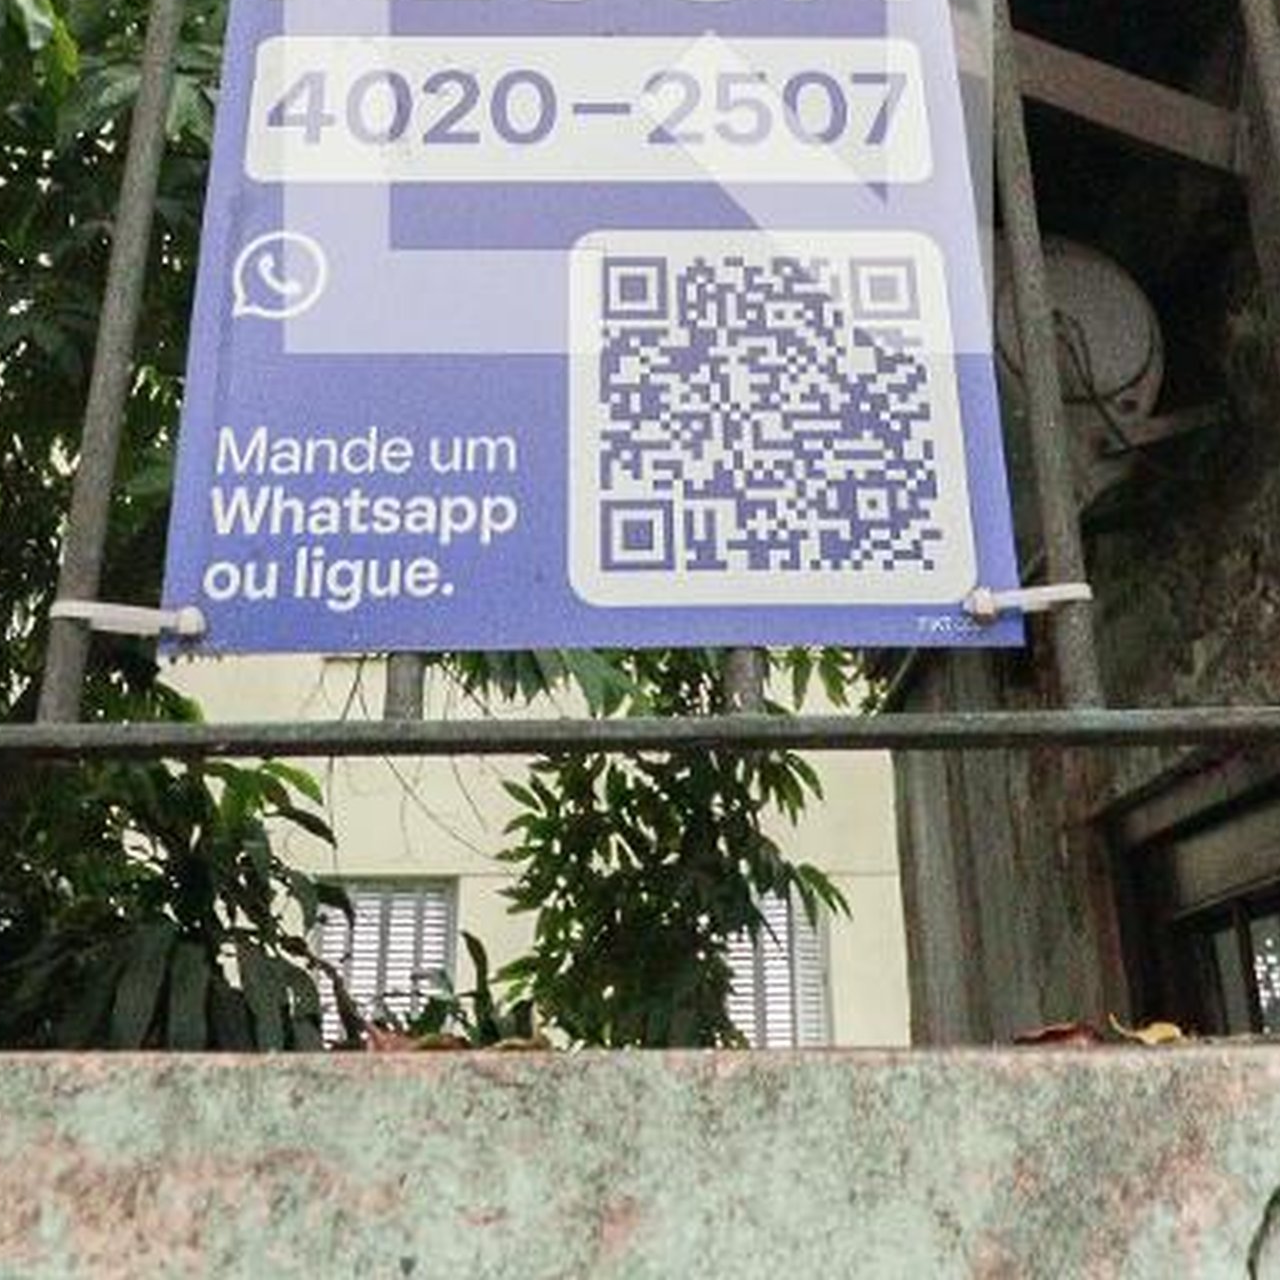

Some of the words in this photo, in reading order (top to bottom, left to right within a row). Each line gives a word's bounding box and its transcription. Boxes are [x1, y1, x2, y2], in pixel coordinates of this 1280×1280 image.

[215, 426, 415, 475] Mande
[429, 436, 518, 473] um
[211, 486, 518, 545] Whatsapp
[203, 560, 278, 600] ou
[293, 545, 455, 612] ligue.
